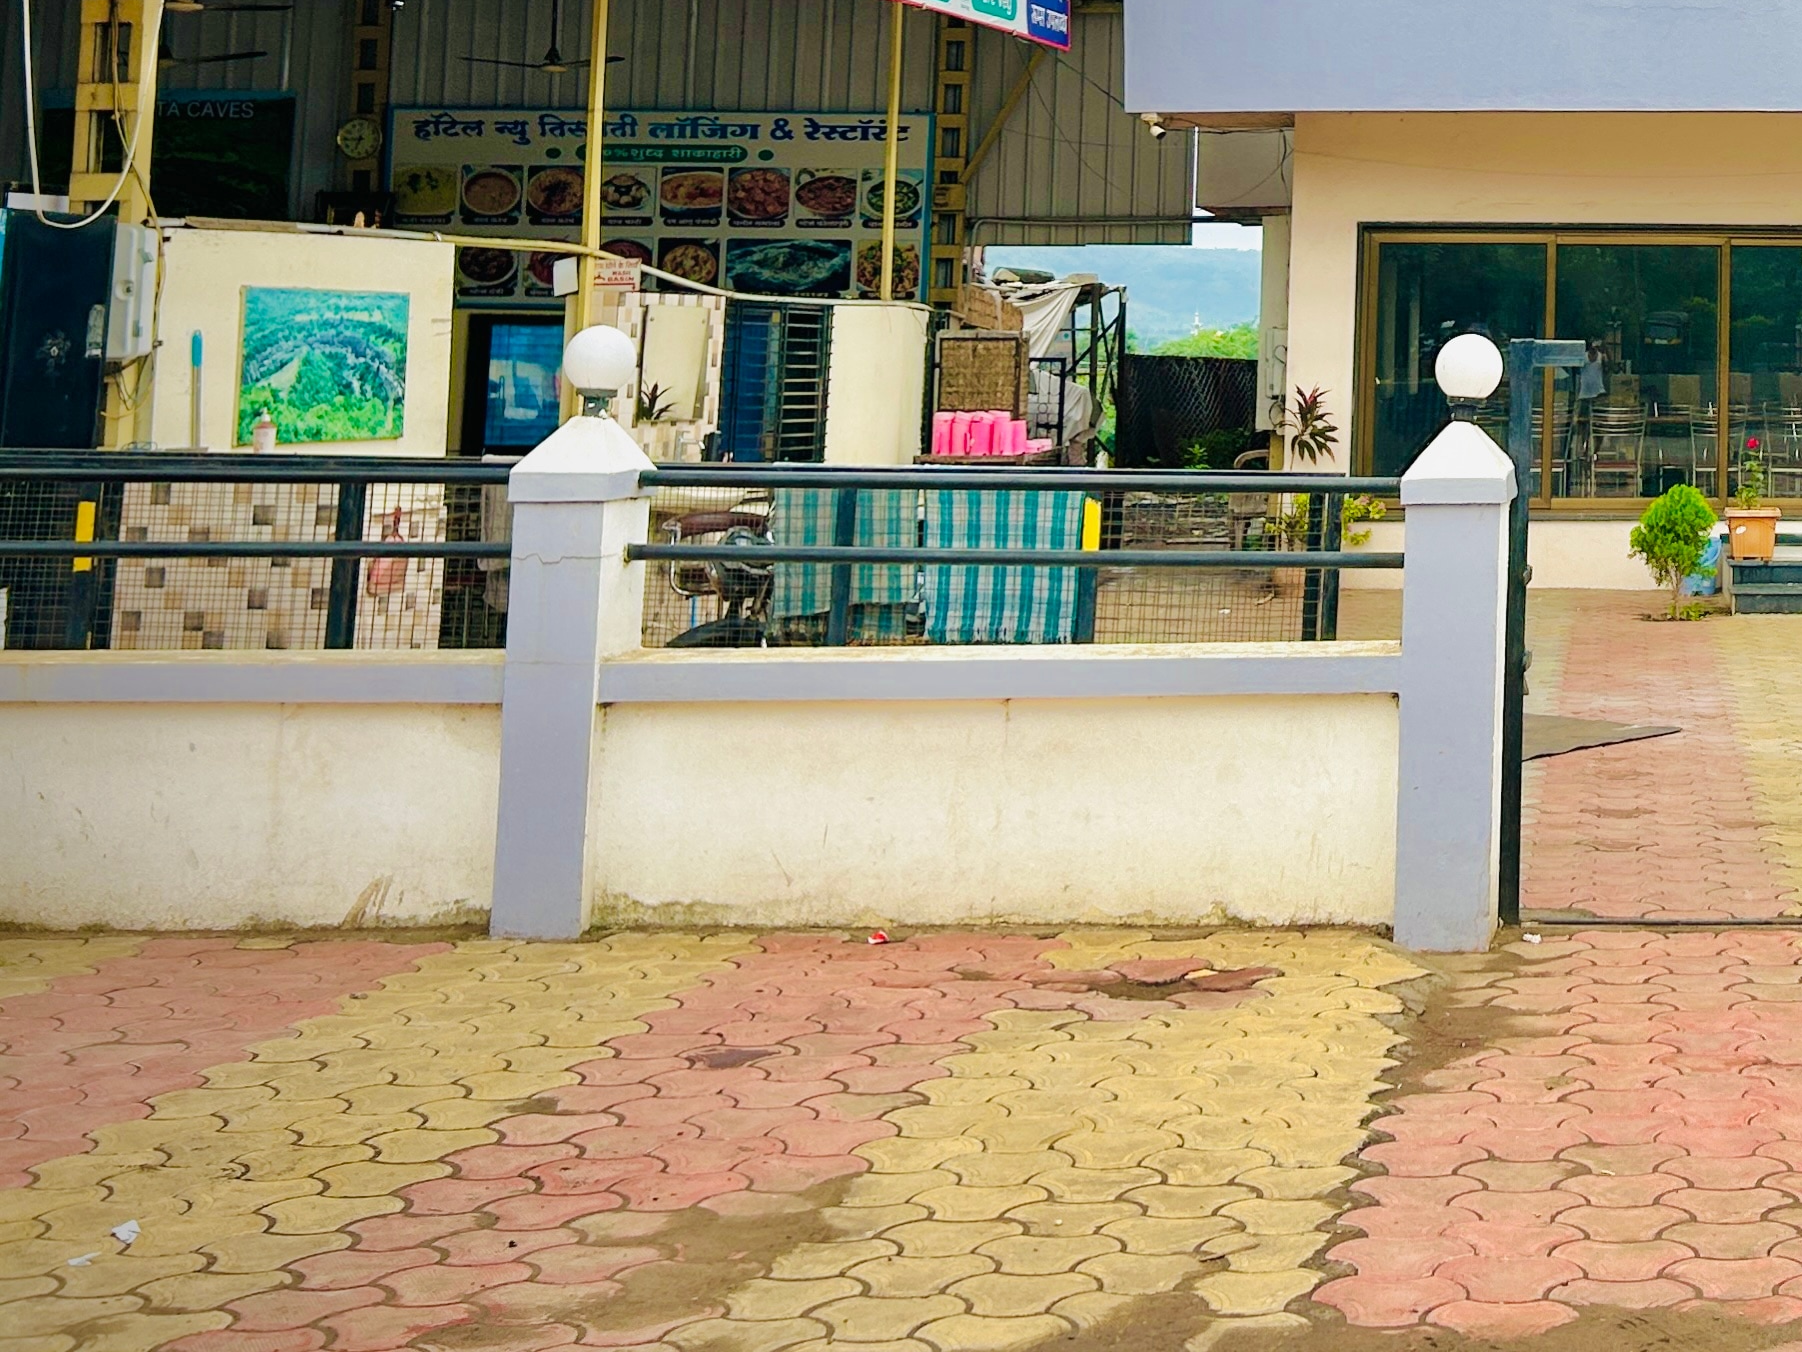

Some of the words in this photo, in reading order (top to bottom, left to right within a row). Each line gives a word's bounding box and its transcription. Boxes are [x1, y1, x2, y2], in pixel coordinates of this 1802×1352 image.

[187, 101, 254, 118] CAVES
[412, 111, 485, 141] हॉटेल
[648, 115, 762, 141] लॉजिंग
[769, 117, 795, 141] &
